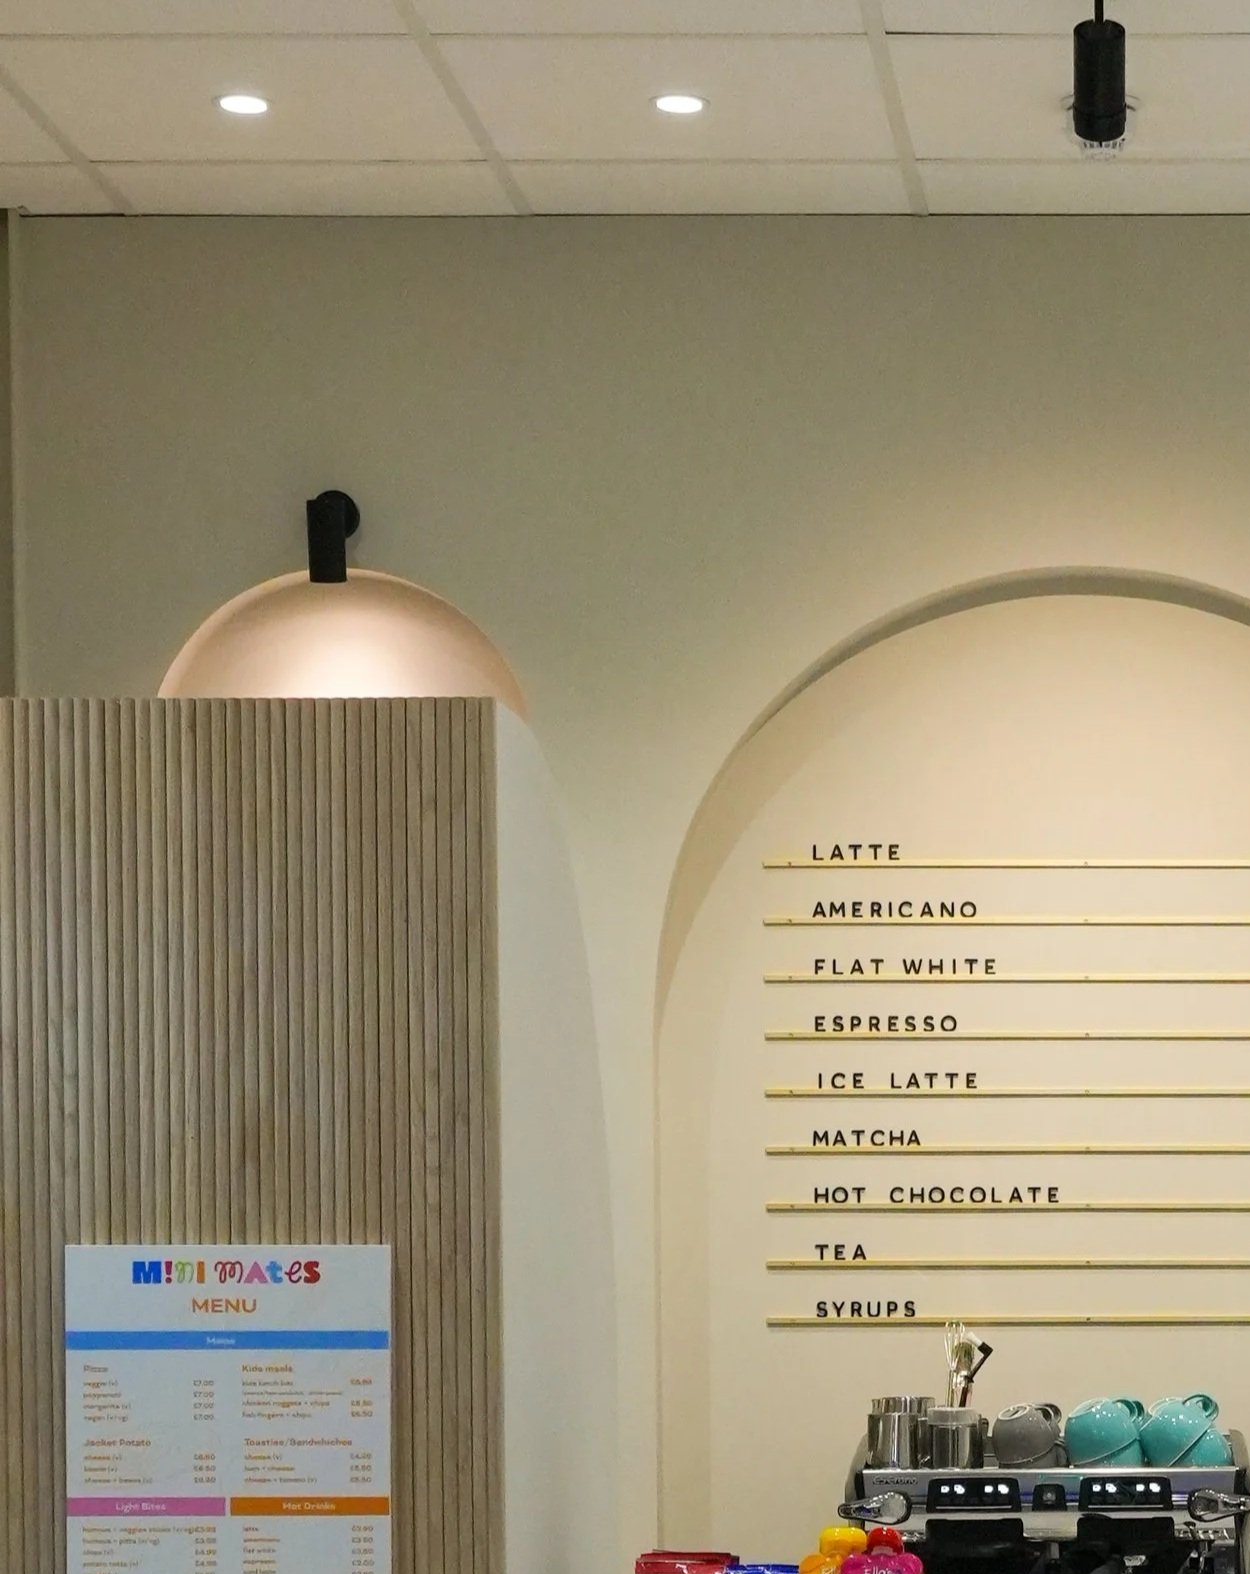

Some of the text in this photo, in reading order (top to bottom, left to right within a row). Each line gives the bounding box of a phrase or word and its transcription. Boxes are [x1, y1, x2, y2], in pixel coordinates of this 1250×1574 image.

[811, 843, 902, 861] LATTE
[811, 900, 979, 919] AMERICANO
[813, 958, 885, 976] FLAT
[901, 958, 998, 976] WHITE
[812, 1015, 959, 1033] ESPRESSO
[816, 1072, 866, 1090] ICE
[889, 1072, 980, 1090] LATTE
[811, 1129, 922, 1147] MATCHA
[813, 1186, 868, 1205] HOT
[888, 1186, 1061, 1205] CHOCOLATE
[814, 1243, 868, 1262] TEA
[191, 1299, 257, 1313] MENU
[815, 1300, 917, 1319] SYRUPS
[119, 1439, 152, 1447] Potato
[116, 1502, 167, 1512] Light Bites
[282, 1502, 336, 1511] Hot Drinks
